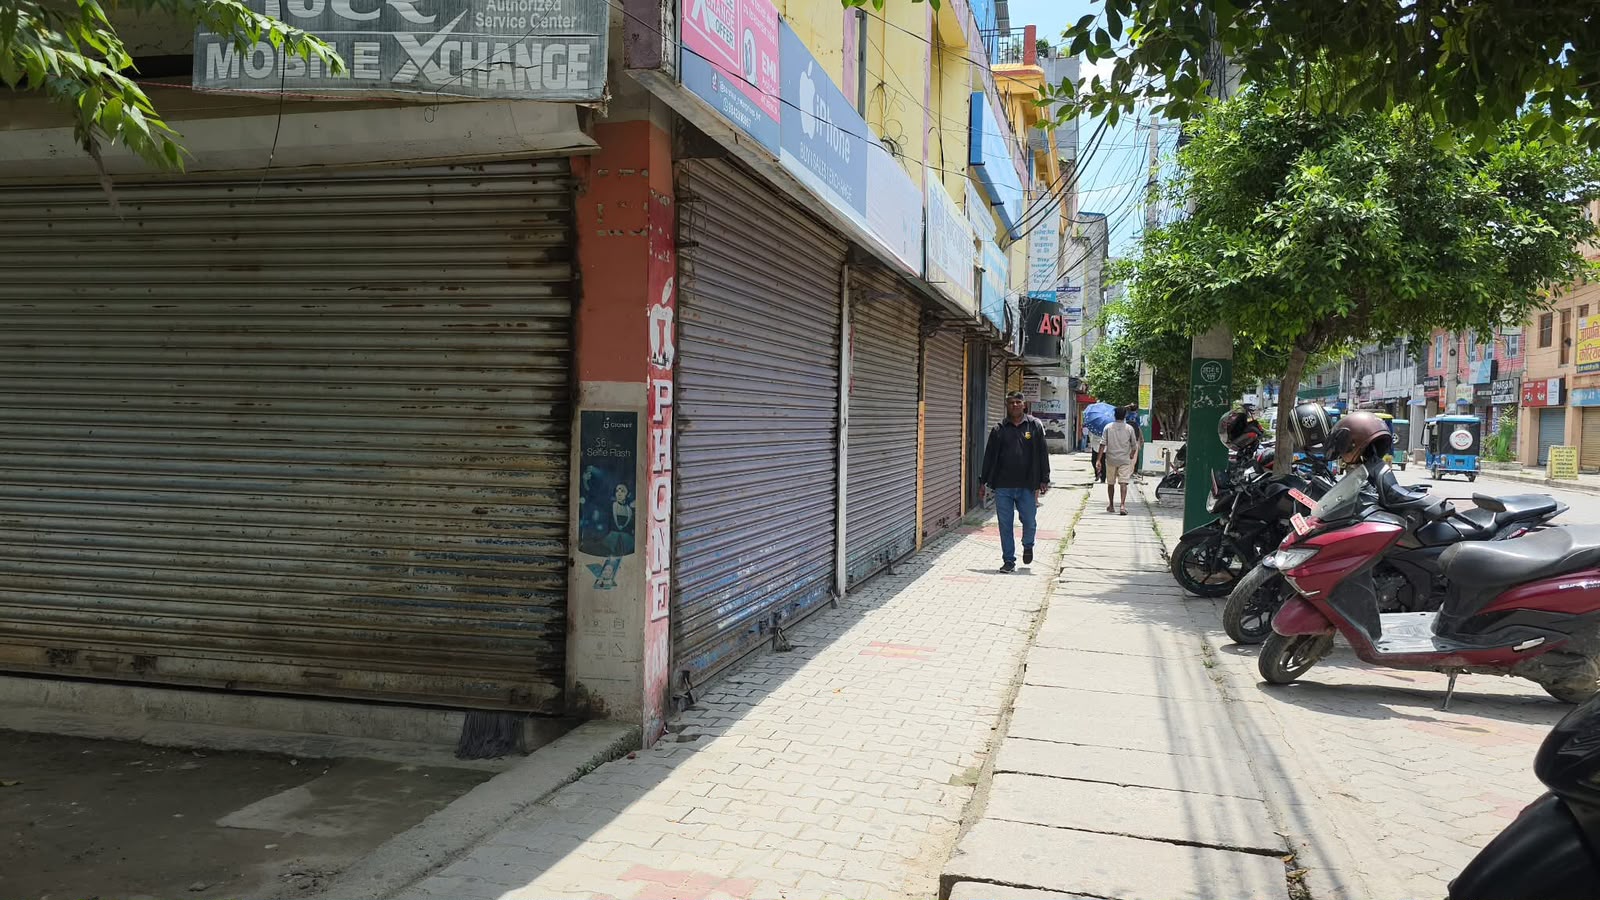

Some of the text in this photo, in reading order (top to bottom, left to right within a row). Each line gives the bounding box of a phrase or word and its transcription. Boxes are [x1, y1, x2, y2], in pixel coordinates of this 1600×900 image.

[475, 12, 577, 28] Service Center
[715, 19, 734, 48] OFFER
[206, 41, 381, 80] MOBILE
[762, 51, 777, 84] EMI
[815, 94, 850, 165] iPhone
[609, 448, 631, 457] Flash
